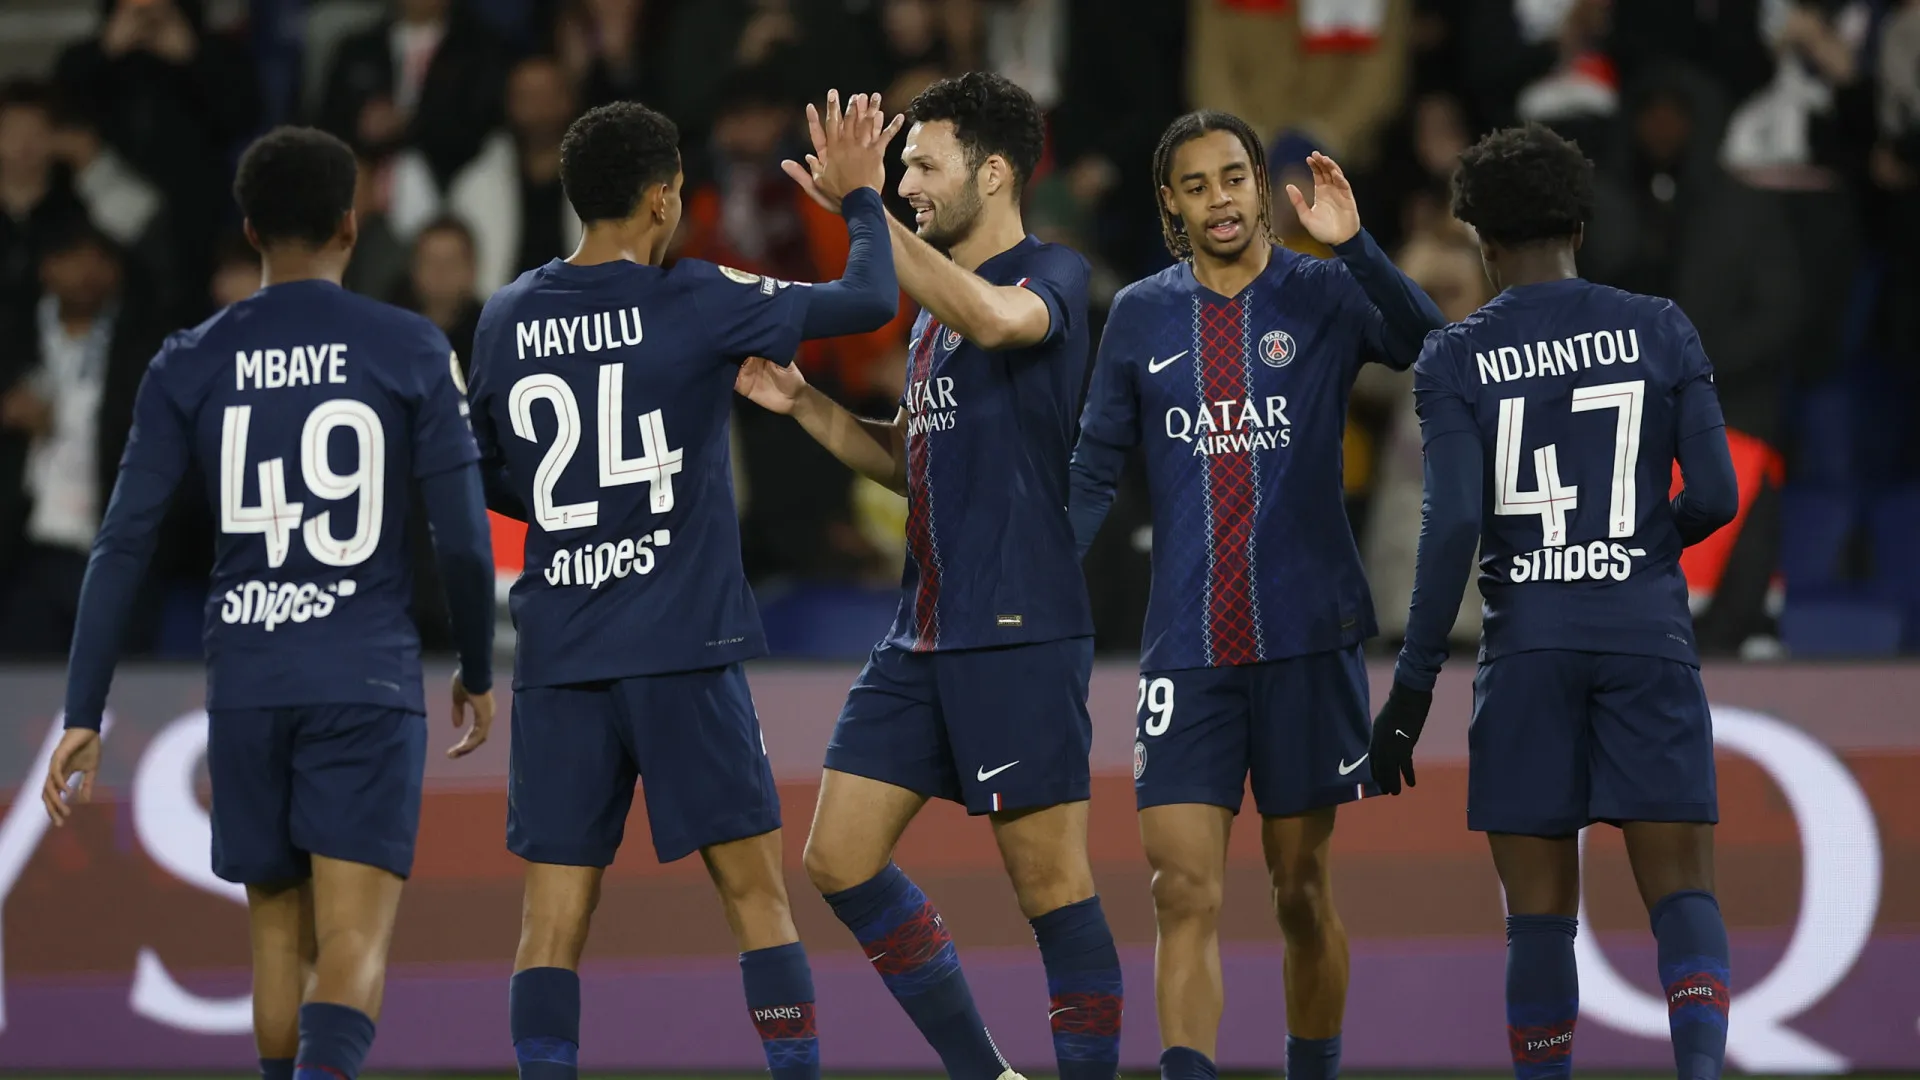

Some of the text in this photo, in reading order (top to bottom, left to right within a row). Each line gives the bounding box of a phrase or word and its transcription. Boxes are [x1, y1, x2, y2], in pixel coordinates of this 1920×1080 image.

[516, 307, 643, 360] MAYULU
[1264, 332, 1289, 343] PARIS
[1476, 329, 1640, 385] NDJANTOU
[236, 343, 347, 391] MBAYE
[906, 376, 958, 414] ATAR
[1165, 395, 1291, 443] QATAR
[508, 363, 683, 532] 24
[1193, 428, 1291, 456] AIRWAYS
[1494, 380, 1645, 547] 47
[220, 399, 385, 568] 49
[544, 533, 655, 590] snipes
[221, 580, 338, 632] snipes
[755, 1006, 801, 1021] PARIS
[1671, 986, 1713, 1003] PARIS
[1528, 1031, 1573, 1051] PARIS
